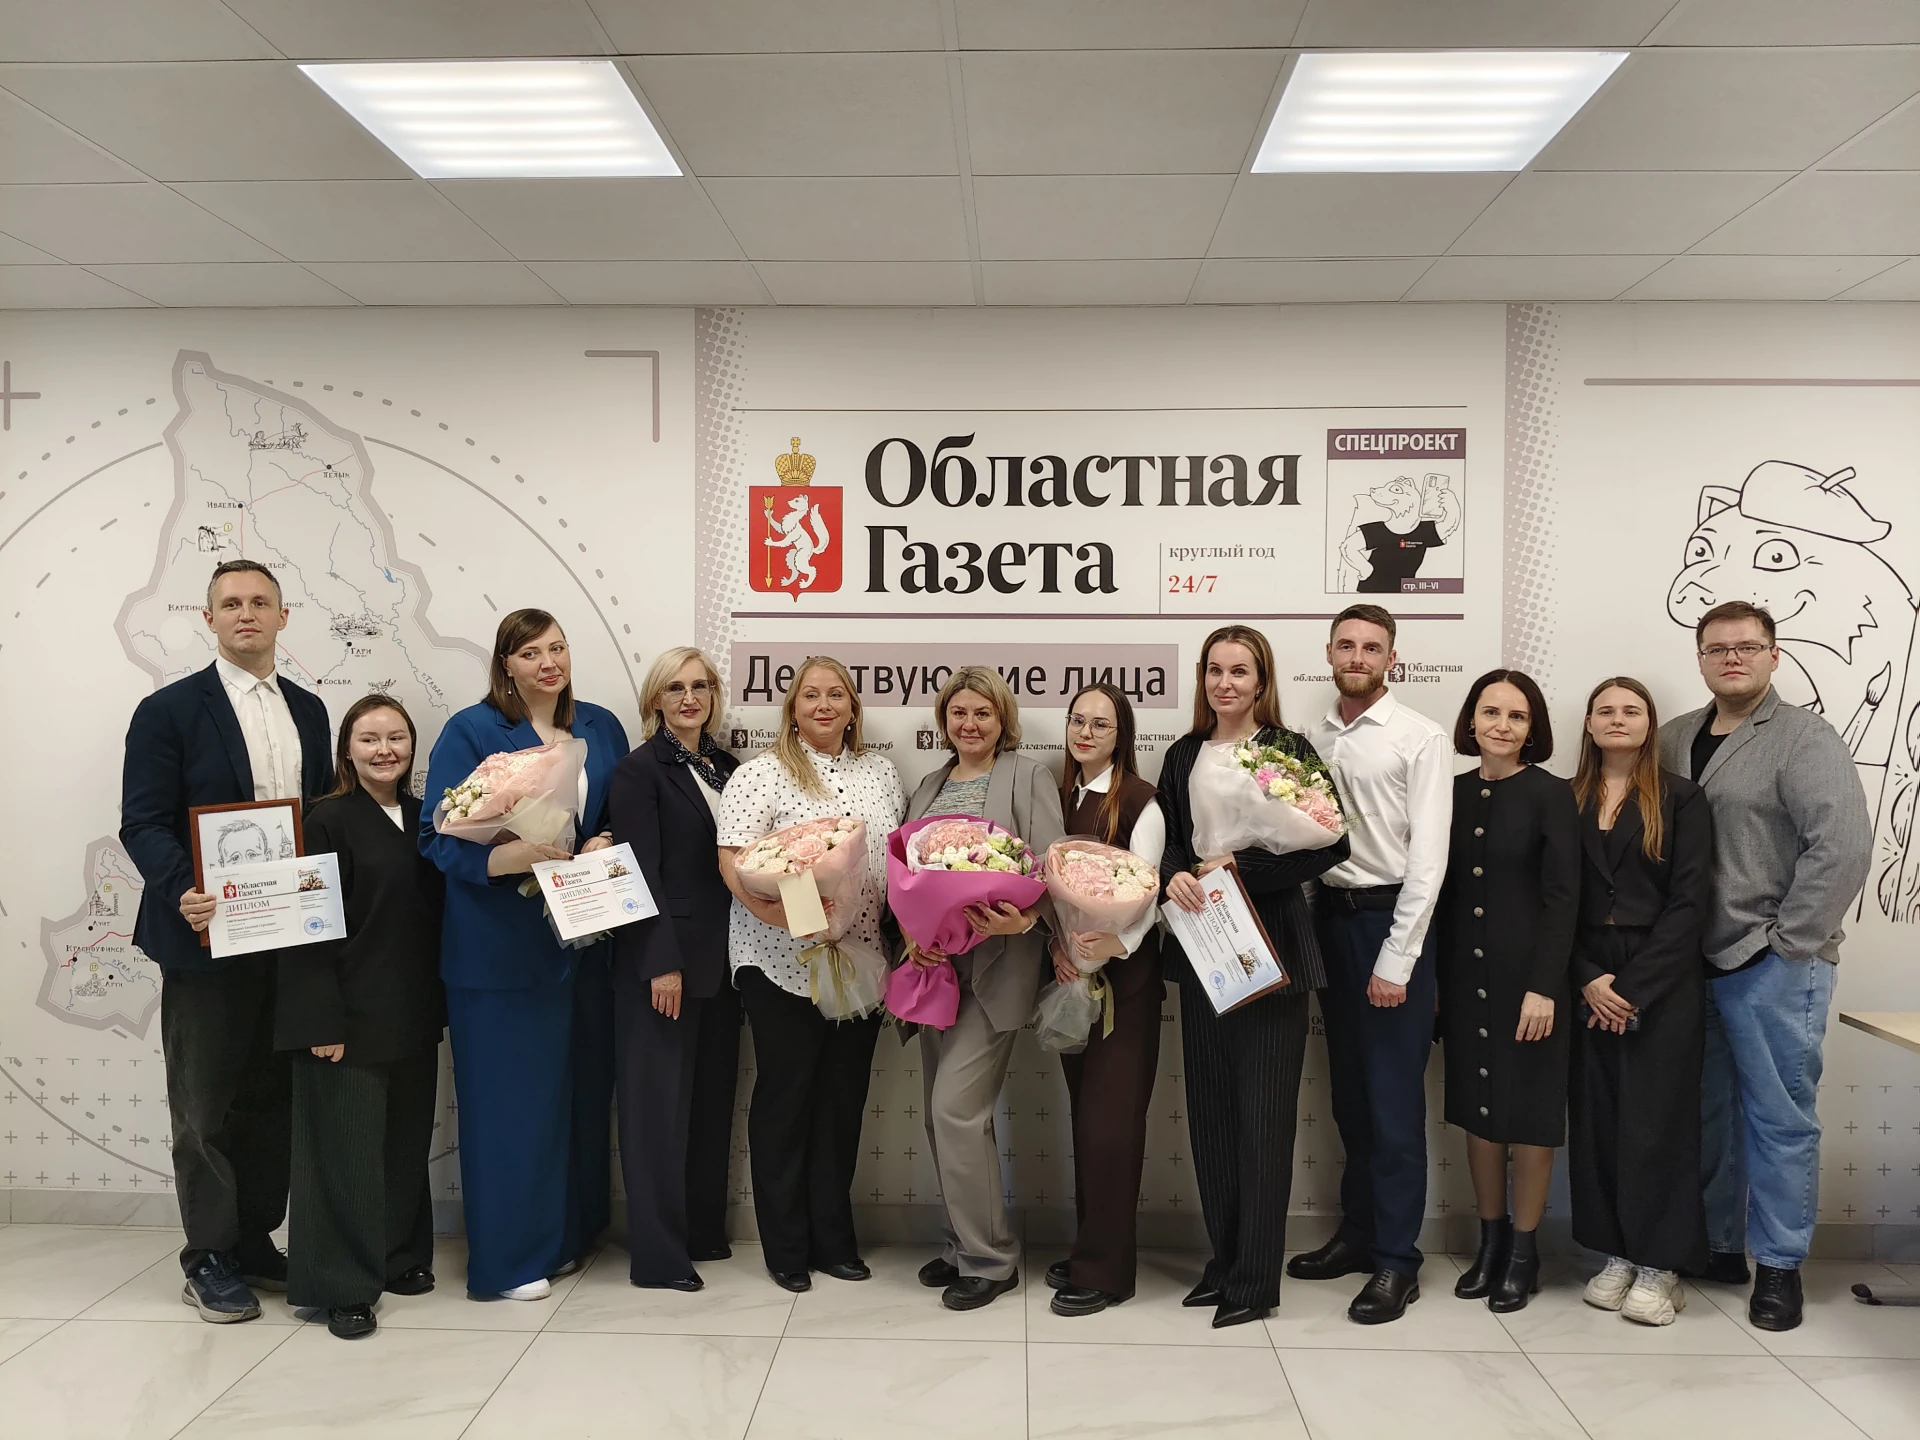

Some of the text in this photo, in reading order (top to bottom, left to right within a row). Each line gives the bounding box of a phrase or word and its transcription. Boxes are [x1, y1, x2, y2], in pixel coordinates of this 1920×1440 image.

[1334, 433, 1459, 454] СПЕЦПРОЕКТ
[864, 431, 1303, 508] Областная
[864, 525, 1119, 594] Газета
[1169, 544, 1276, 561] круглый год
[1168, 575, 1218, 593] 24/7
[1408, 662, 1463, 673] Областная
[743, 655, 1165, 705] Детвуюие лица
[1408, 674, 1441, 683] Газета
[751, 729, 781, 738] Облас
[751, 740, 775, 748] Газе
[238, 880, 277, 890] Областная
[238, 889, 262, 898] Газета
[560, 887, 592, 900] ДИПЛОМ
[225, 900, 270, 914] ДИПЛОМ
[1203, 901, 1222, 935] ИПЛОМ
[1220, 900, 1239, 933] Областная
